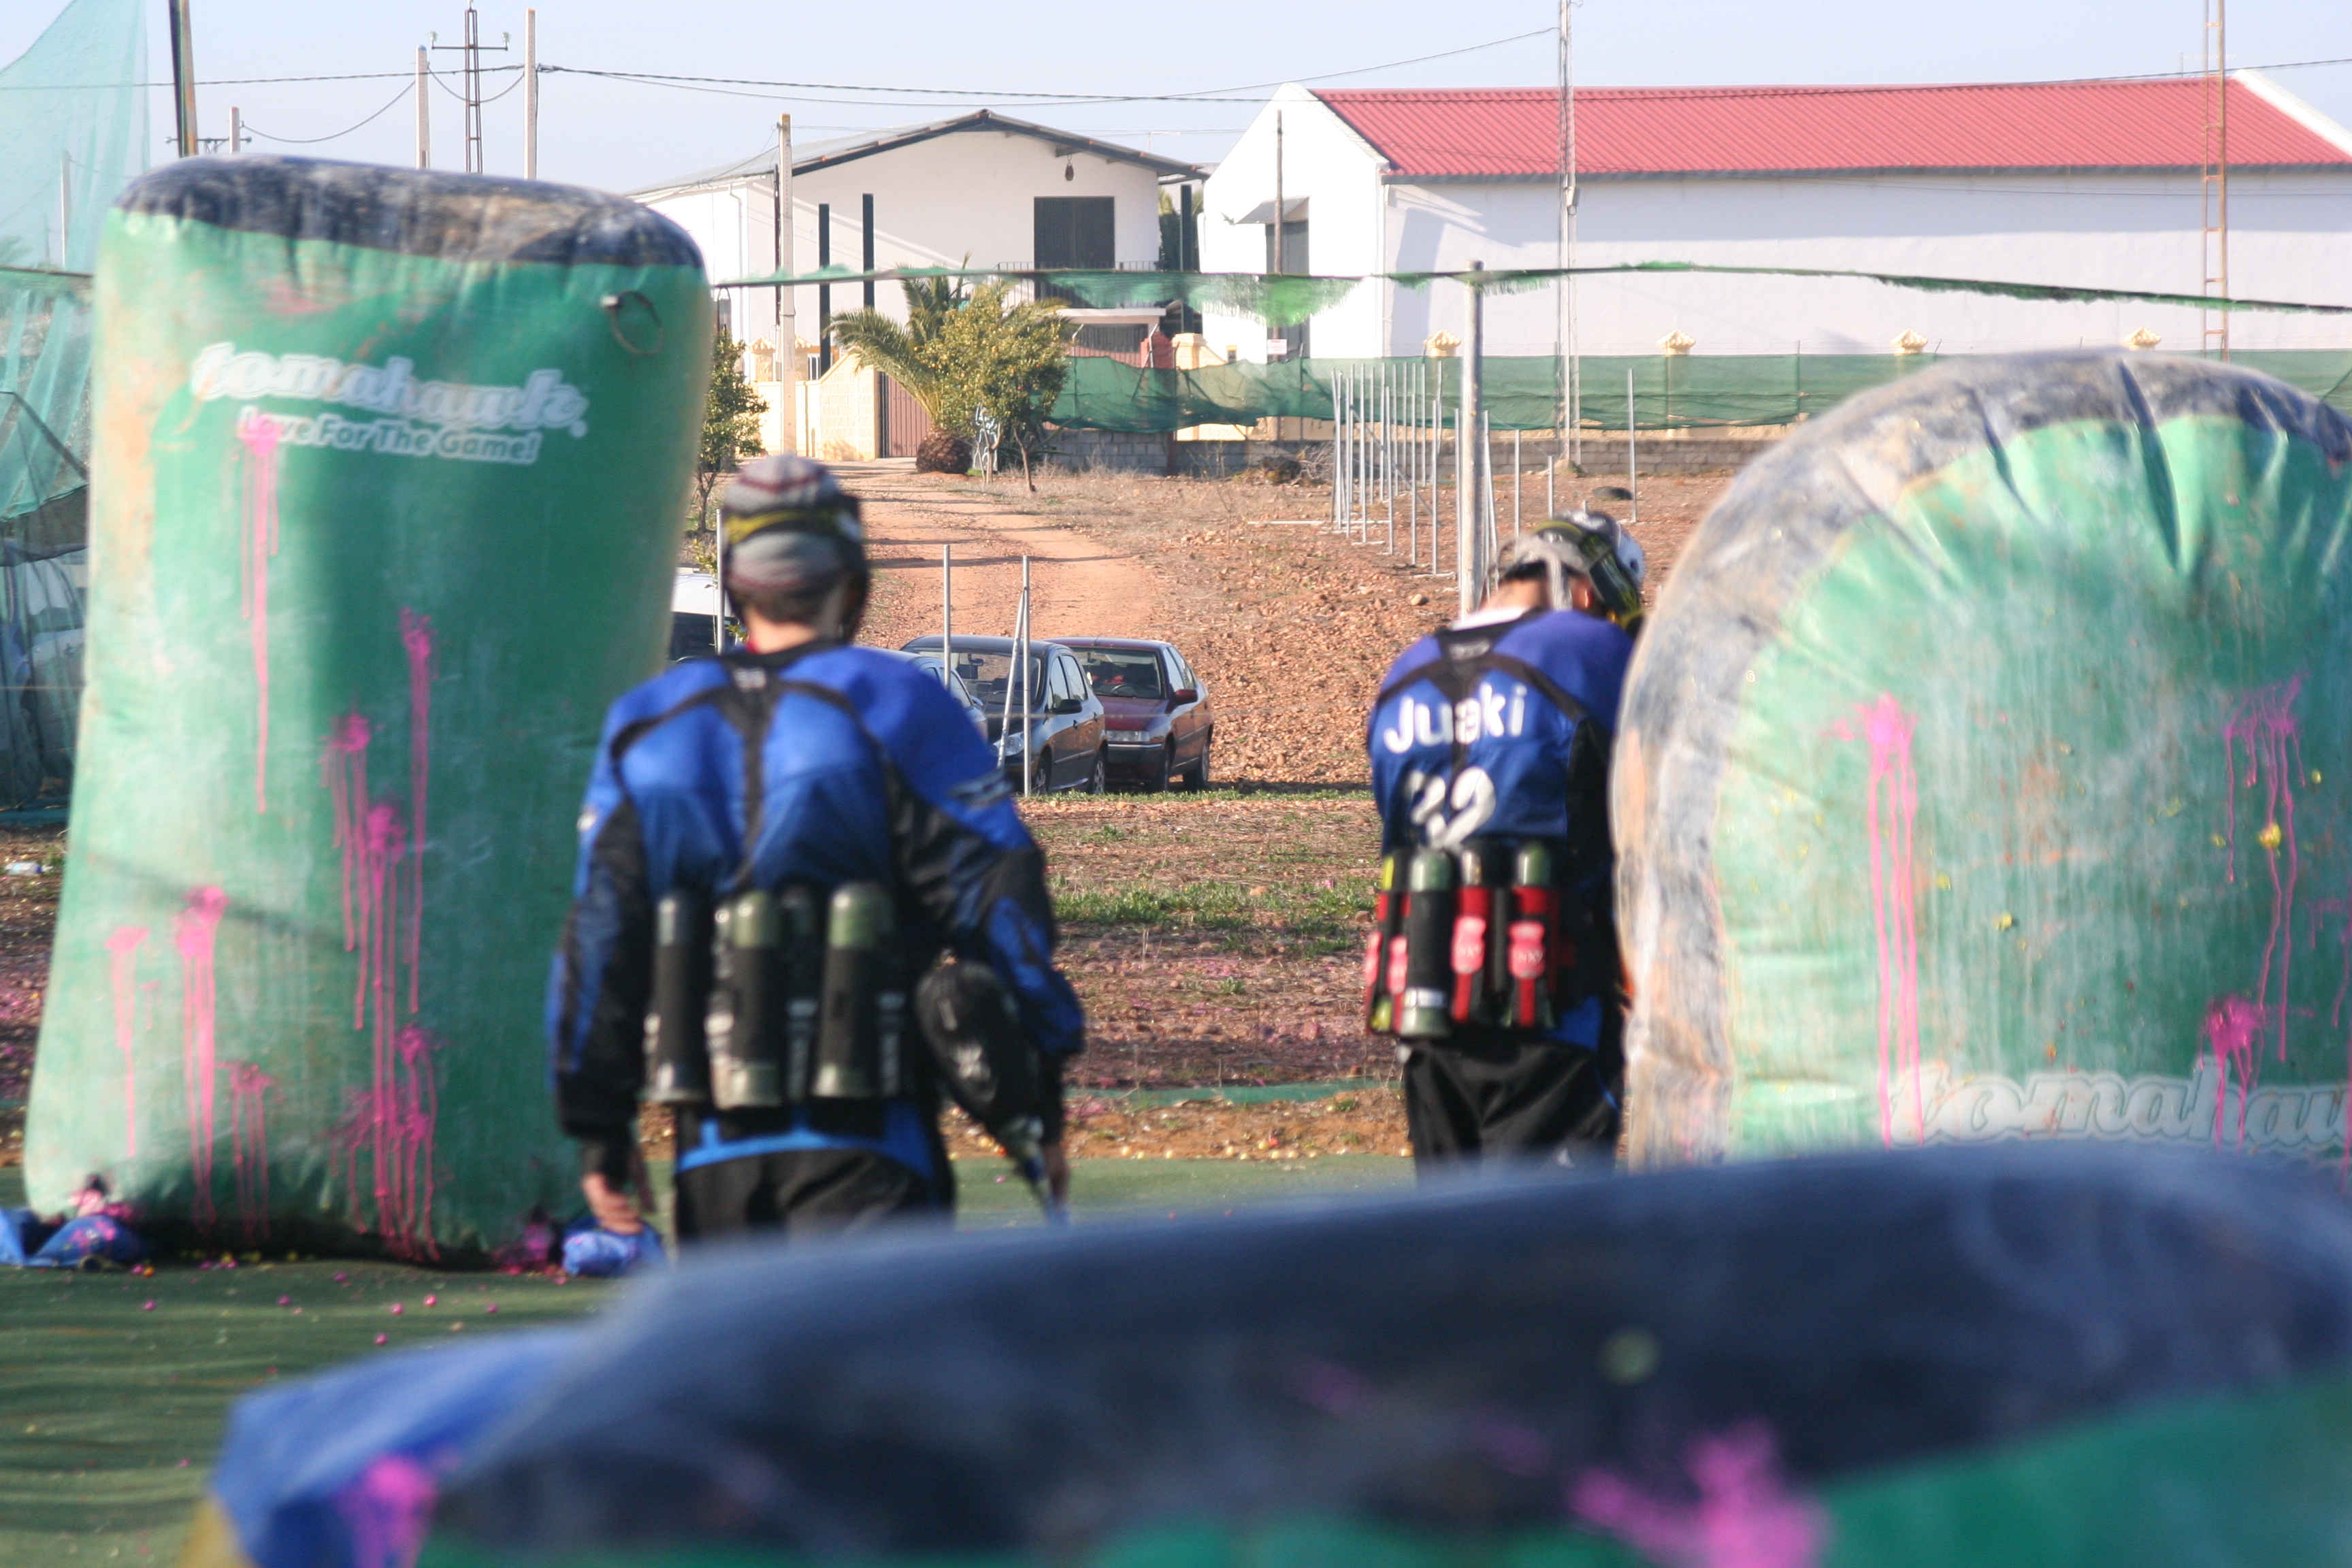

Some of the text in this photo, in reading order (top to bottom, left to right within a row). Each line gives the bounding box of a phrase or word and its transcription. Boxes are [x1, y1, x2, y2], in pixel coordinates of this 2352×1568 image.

[192, 342, 589, 430] tomahawk
[317, 413, 373, 451] For
[371, 418, 436, 457] The
[1384, 682, 1529, 754] Juaki
